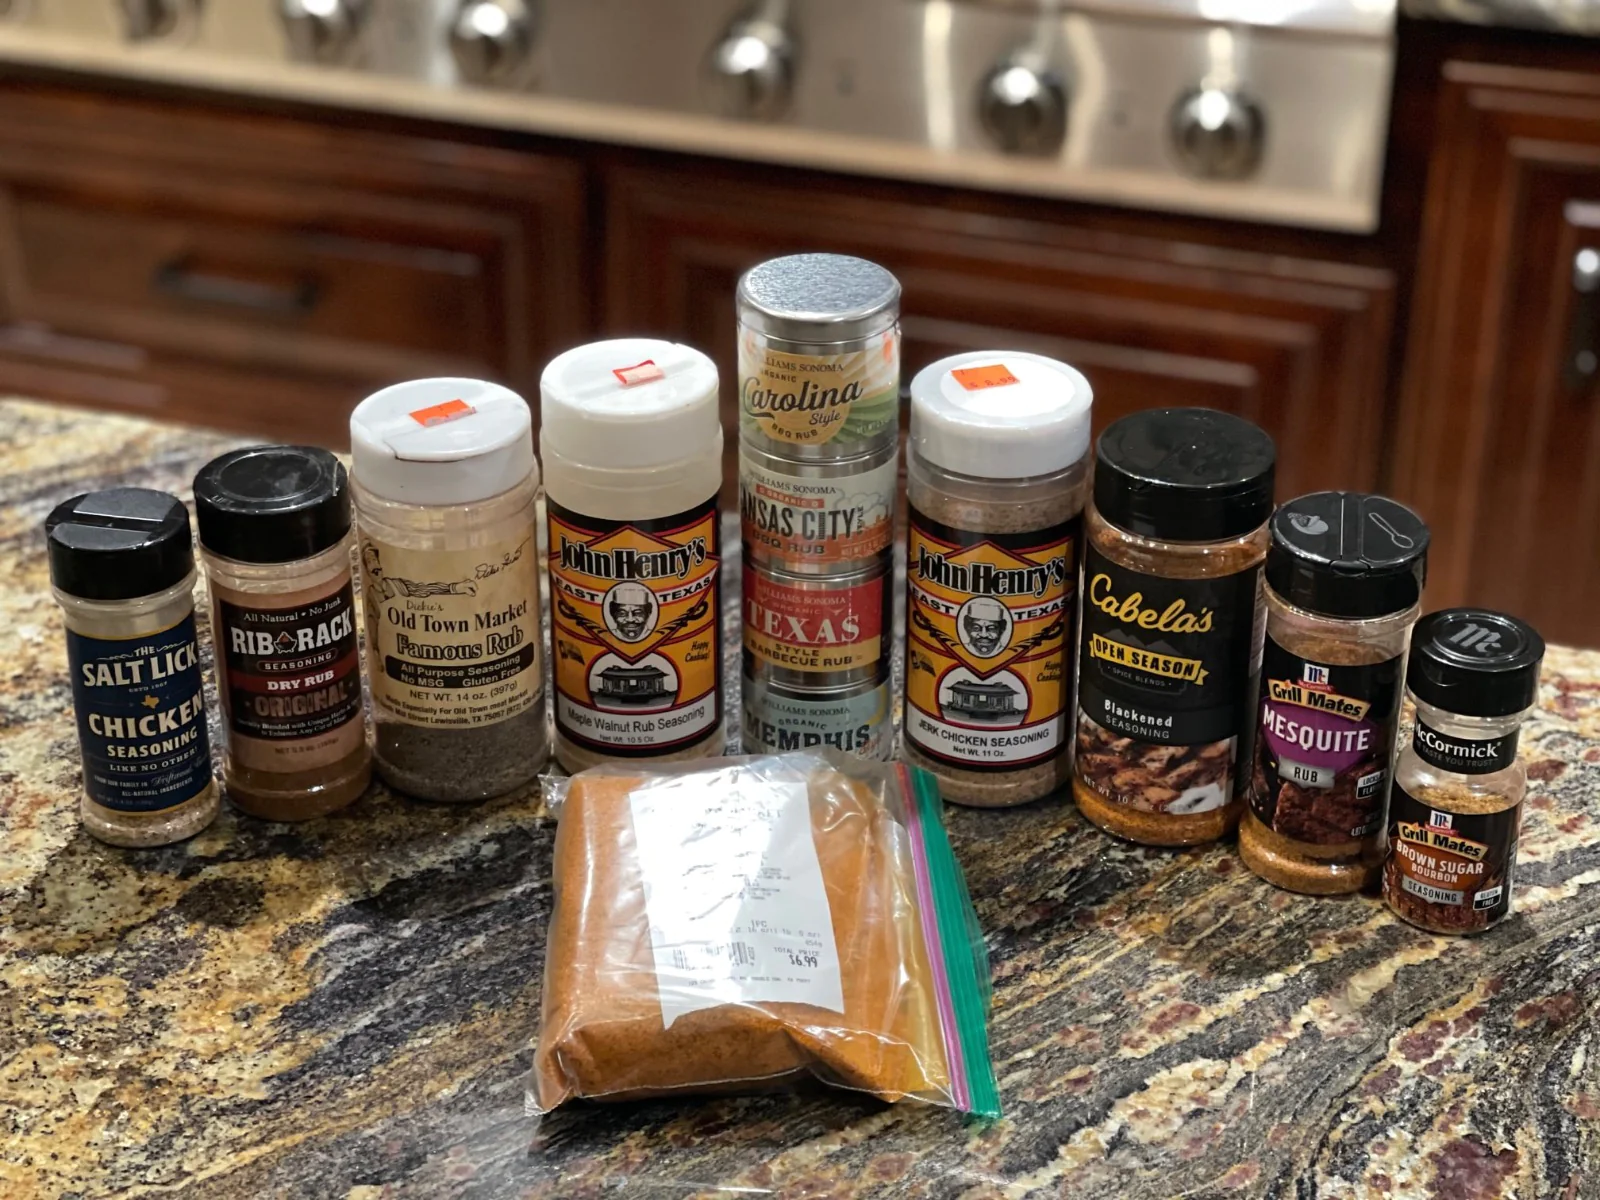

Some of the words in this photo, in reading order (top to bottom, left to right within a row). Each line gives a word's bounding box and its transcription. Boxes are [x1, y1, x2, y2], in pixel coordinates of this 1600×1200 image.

[760, 368, 797, 383] RGANIC
[799, 363, 844, 373] SONOMA
[743, 375, 864, 419] Carolina
[771, 422, 792, 439] BBQ
[796, 429, 818, 440] RUB
[808, 409, 841, 428] Style
[792, 484, 837, 494] SONOMA
[740, 484, 794, 538] ANSAS
[801, 507, 856, 541] CITY
[559, 533, 612, 579] John
[612, 537, 707, 582] Henry's
[788, 543, 825, 555] RUB
[918, 542, 969, 593] John
[969, 557, 1066, 598] Henry's
[554, 576, 600, 603] EAST
[658, 575, 712, 603] TEXAS
[803, 595, 846, 606] SONOMA
[243, 612, 258, 622] All
[261, 612, 298, 623] Natural
[309, 606, 323, 617] No
[324, 596, 343, 612] Junk
[387, 606, 416, 630] Old
[419, 614, 469, 634] Town
[474, 599, 528, 632] Market
[406, 600, 444, 612] Dickie's
[911, 585, 955, 614] EAST
[1013, 599, 1069, 621] TEXAS
[1090, 573, 1214, 634] Cabela's
[230, 626, 275, 656] RIB
[297, 606, 353, 652] RACK
[747, 597, 860, 645] TEXAS
[133, 645, 156, 657] THE
[396, 632, 483, 661] Famous
[486, 625, 525, 656] Rub
[750, 640, 819, 667] BARBECUE
[823, 656, 853, 667] RUB
[775, 643, 820, 657] STYLE
[81, 659, 144, 687] SALT
[150, 641, 198, 681] LICK
[264, 652, 333, 670] SEASONING
[400, 662, 415, 674] All
[417, 666, 465, 679] Purpose
[467, 655, 521, 676] Seasoning
[1095, 637, 1125, 661] OPEN
[1130, 651, 1196, 677] SEASON
[267, 680, 301, 691] DRY
[304, 670, 335, 687] RUB
[400, 674, 415, 685] No
[418, 677, 445, 688] MSG
[462, 674, 499, 688] Gluten
[500, 665, 521, 681] Free
[1111, 666, 1133, 680] SPICE
[1135, 675, 1166, 688] BLENDS
[254, 682, 349, 717] ORIGINAL
[402, 701, 438, 715] Especially
[439, 707, 452, 715] For
[453, 707, 467, 715] Old
[469, 705, 488, 714] Town
[508, 688, 528, 704] Market
[409, 689, 429, 700] NET
[456, 693, 469, 702] 14
[472, 692, 488, 700] oz.
[490, 683, 518, 698] (397g)
[1272, 683, 1302, 703] Grill
[1307, 692, 1363, 717] Mates
[88, 689, 204, 739] CHICKEN
[407, 712, 430, 723] Street
[567, 706, 593, 727] Maple
[594, 717, 631, 733] Walnut
[633, 719, 655, 733] Rub
[658, 705, 706, 731] Seasoning
[778, 718, 827, 730] ORGANIC
[809, 707, 850, 717] SONOMA
[1104, 698, 1173, 728] Blackened
[746, 711, 870, 752] MEMPHIS
[917, 718, 939, 736] JERK
[940, 727, 988, 747] CHICKEN
[990, 728, 1050, 747] SEASONING
[1105, 714, 1170, 739] SEASONING
[1263, 703, 1371, 753] MESQUITE
[107, 725, 198, 758] SEASONING
[953, 745, 965, 754] Net
[1416, 723, 1499, 758] McCormick
[109, 763, 137, 773] LIKE
[141, 763, 157, 772] NO
[1422, 745, 1443, 761] TASTE
[1445, 757, 1464, 766] YOU
[1293, 765, 1318, 784] RUB
[1402, 825, 1429, 843] Grill
[1433, 835, 1482, 857] Mates
[1396, 839, 1436, 869] BROWN
[1439, 860, 1485, 875] SUGAR
[1411, 862, 1458, 883] BOURBON
[1408, 880, 1458, 902] SEASONING
[798, 949, 821, 957] PRICE
